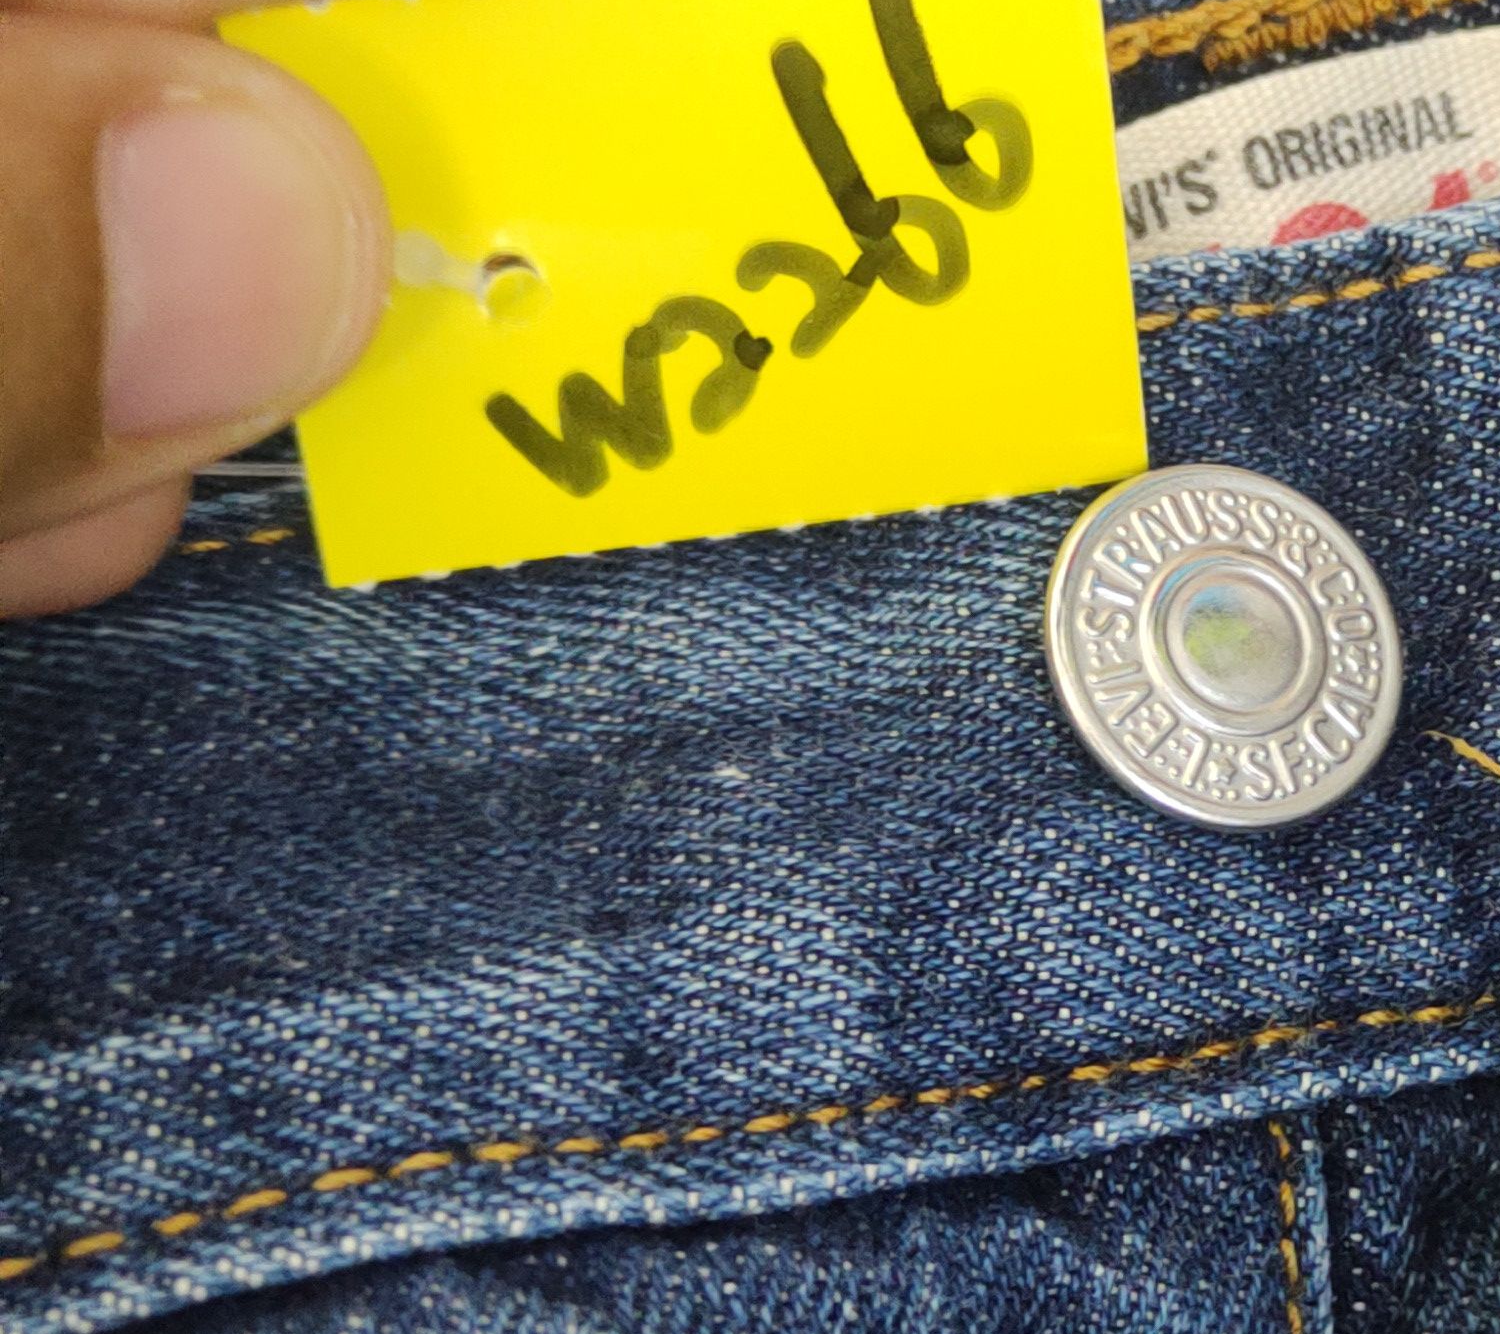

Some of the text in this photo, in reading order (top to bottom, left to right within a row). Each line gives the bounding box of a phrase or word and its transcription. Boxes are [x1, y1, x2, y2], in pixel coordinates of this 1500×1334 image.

[1242, 89, 1473, 192] ORIGINAL
[1077, 487, 1280, 643] STRAUSS
[1278, 522, 1321, 579] &
[1086, 663, 1211, 788] LEVI
